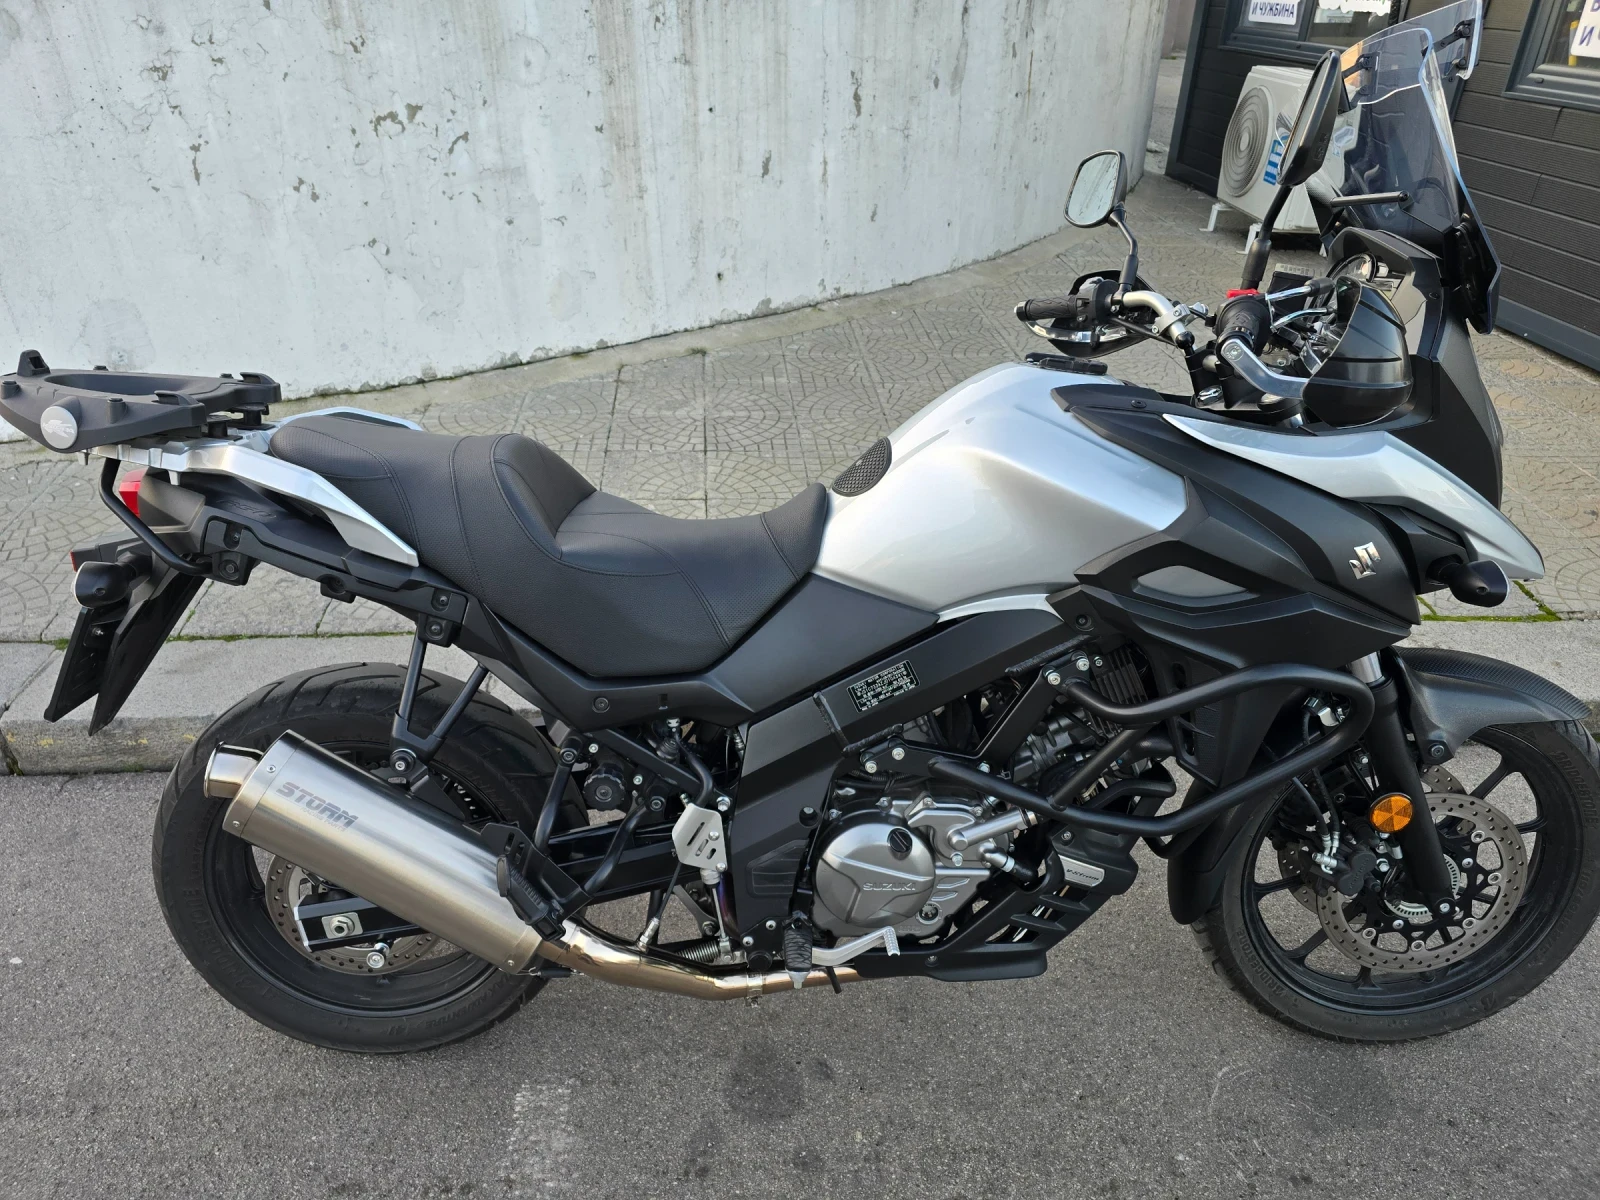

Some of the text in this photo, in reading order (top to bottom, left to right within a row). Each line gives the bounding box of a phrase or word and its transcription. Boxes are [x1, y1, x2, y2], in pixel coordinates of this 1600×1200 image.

[1251, 2, 1295, 18] И ЧУЖБИНА
[1578, 25, 1595, 46] И
[275, 781, 359, 829] STORM
[863, 882, 916, 891] SUZUKI
[1236, 928, 1287, 998] BRIDGESTONE
